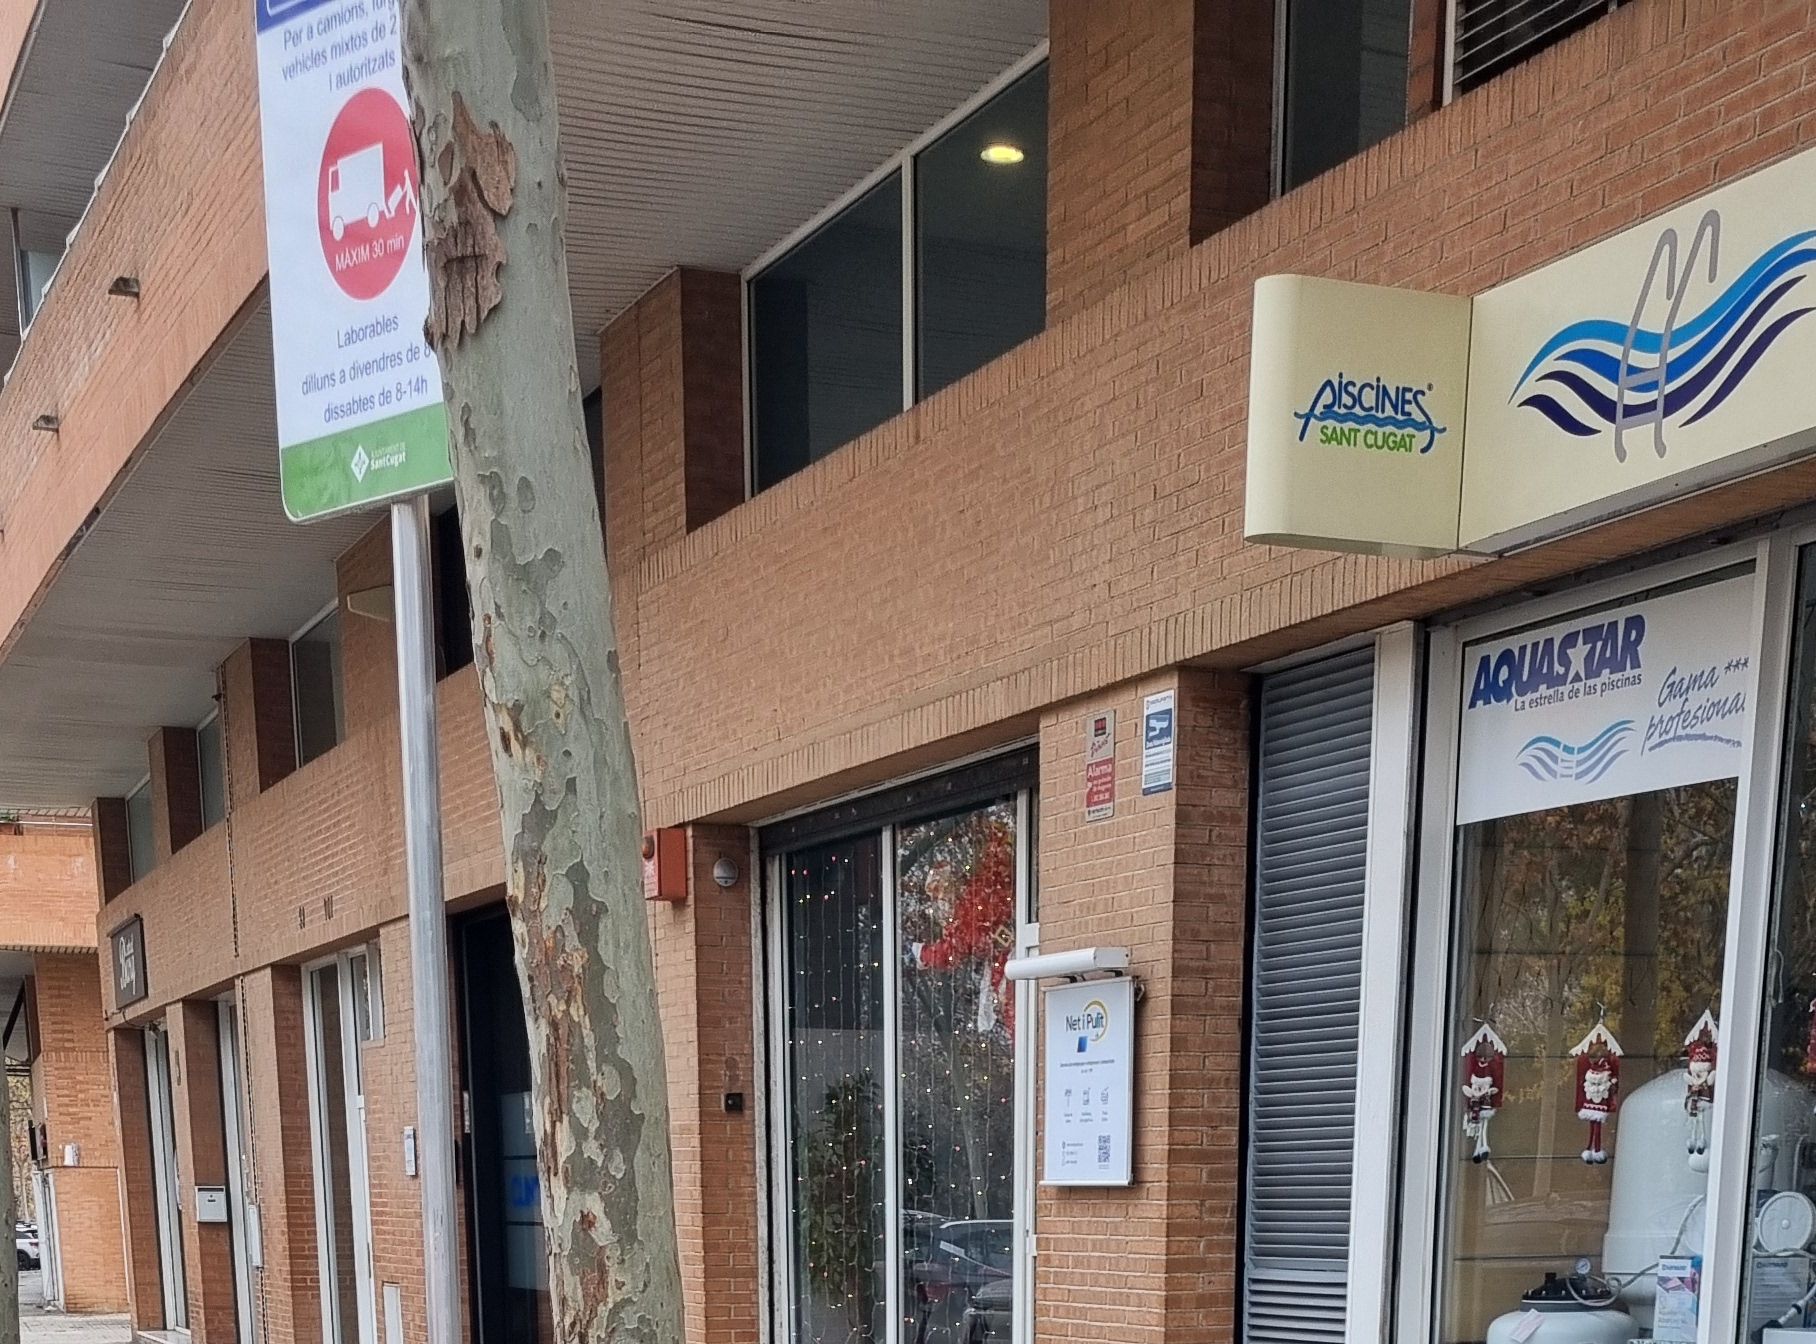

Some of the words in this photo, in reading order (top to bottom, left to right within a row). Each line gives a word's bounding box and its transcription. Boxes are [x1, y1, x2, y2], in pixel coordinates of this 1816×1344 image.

[283, 29, 302, 50] Per
[307, 26, 314, 39] a
[316, 3, 369, 37] camions,
[281, 49, 327, 81] vehicles
[330, 33, 368, 58] mixtos
[371, 24, 386, 43] de
[390, 15, 398, 35] 2
[335, 50, 396, 87] autoritzats
[372, 242, 385, 258] 30
[387, 234, 405, 252] min
[337, 314, 399, 349] Laborables
[301, 367, 336, 396] dilluns
[339, 369, 346, 385] a
[349, 348, 403, 381] divendres
[406, 341, 420, 363] de
[323, 391, 375, 424] dissabtes
[378, 385, 392, 408] de
[395, 377, 429, 402] 8-14h
[1319, 424, 1360, 448] SANT
[1363, 429, 1416, 453] CUGAT
[1468, 614, 1647, 712] AQUASTAR
[1514, 698, 1526, 712] La
[1529, 689, 1565, 709] estrella
[1568, 685, 1581, 701] de
[1583, 681, 1598, 698] las
[1601, 673, 1642, 697] piscinas
[1657, 666, 1719, 707] Gama
[1065, 1014, 1081, 1032] Net
